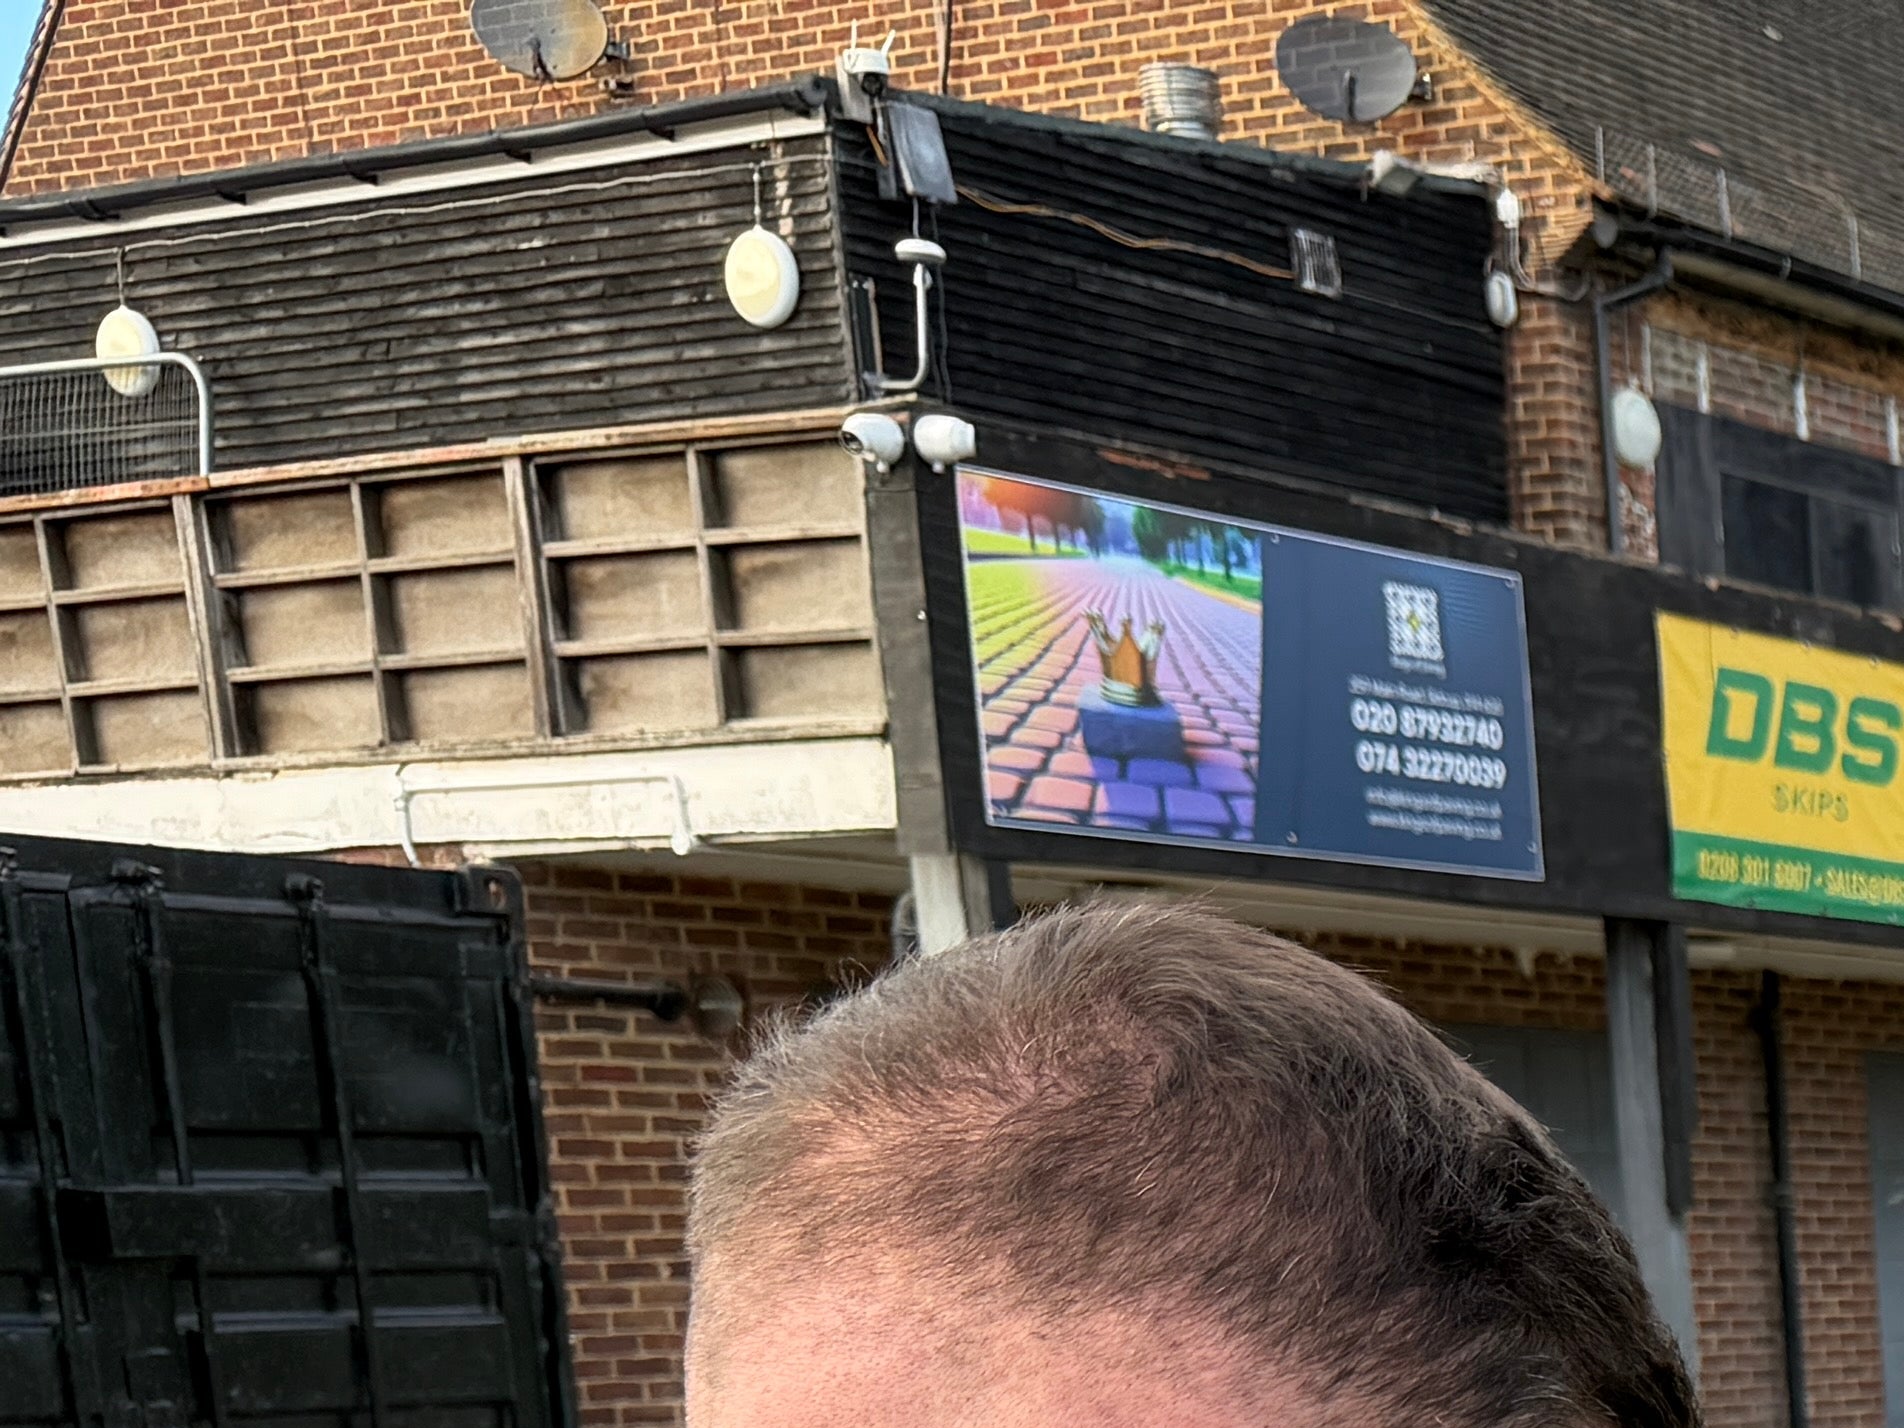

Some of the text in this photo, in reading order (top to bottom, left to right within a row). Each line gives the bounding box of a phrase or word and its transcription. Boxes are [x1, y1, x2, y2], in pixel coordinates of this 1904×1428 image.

[1351, 697, 1397, 735] 020
[1399, 704, 1503, 750] 87932740
[1705, 665, 1904, 787] DBS
[1355, 739, 1400, 776] 074
[1772, 782, 1849, 822] SKIPS
